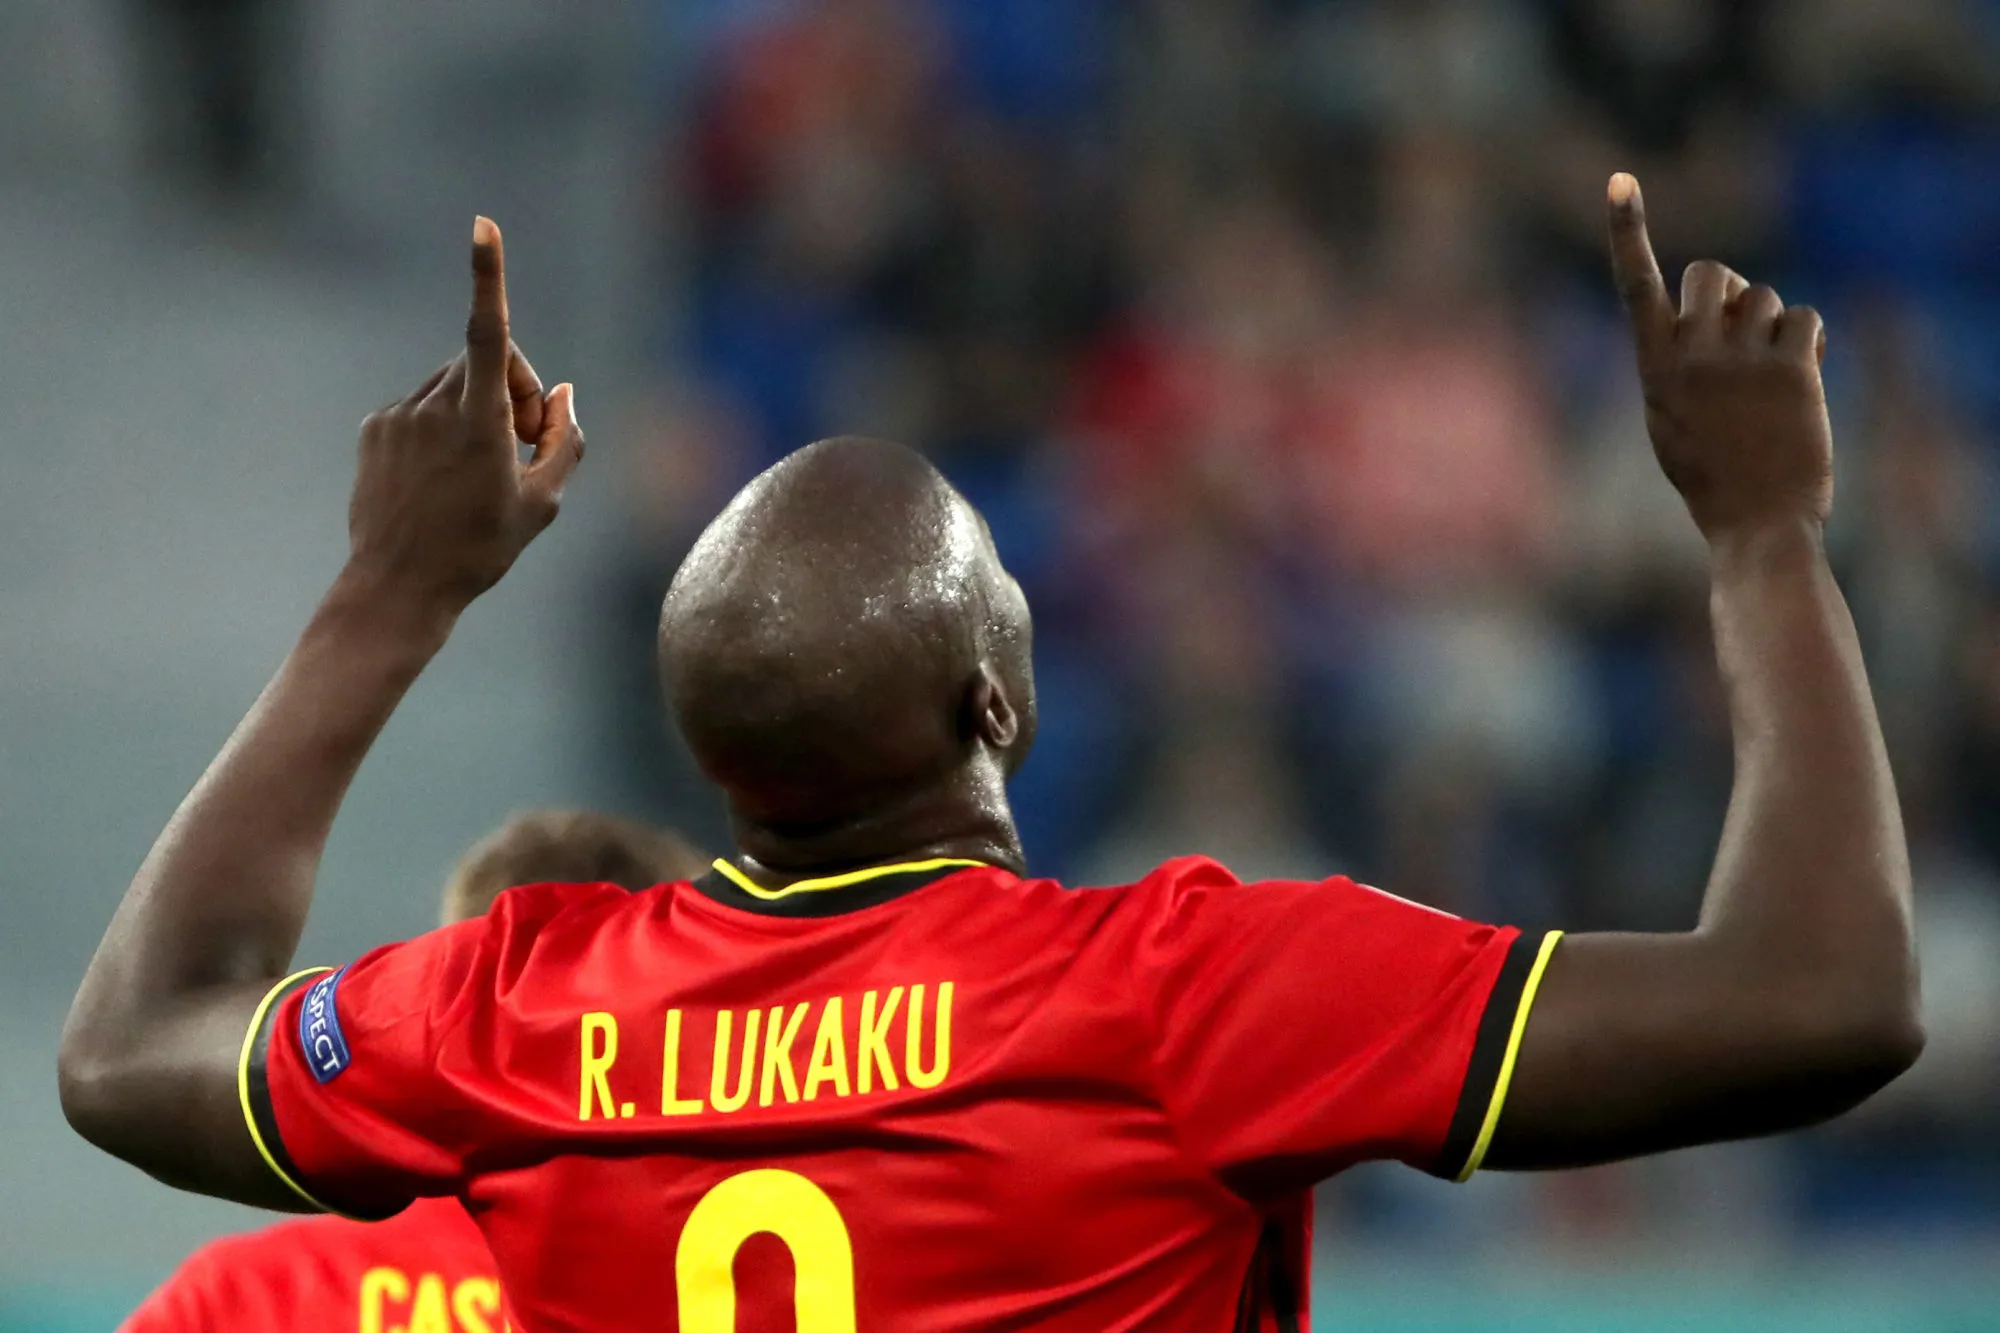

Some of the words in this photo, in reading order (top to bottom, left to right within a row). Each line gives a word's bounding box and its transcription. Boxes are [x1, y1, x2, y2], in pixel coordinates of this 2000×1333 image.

[309, 971, 341, 1072] ESPECT
[578, 1011, 636, 1121] R.
[661, 981, 955, 1117] LUKAKU
[359, 1266, 512, 1333] CAS
